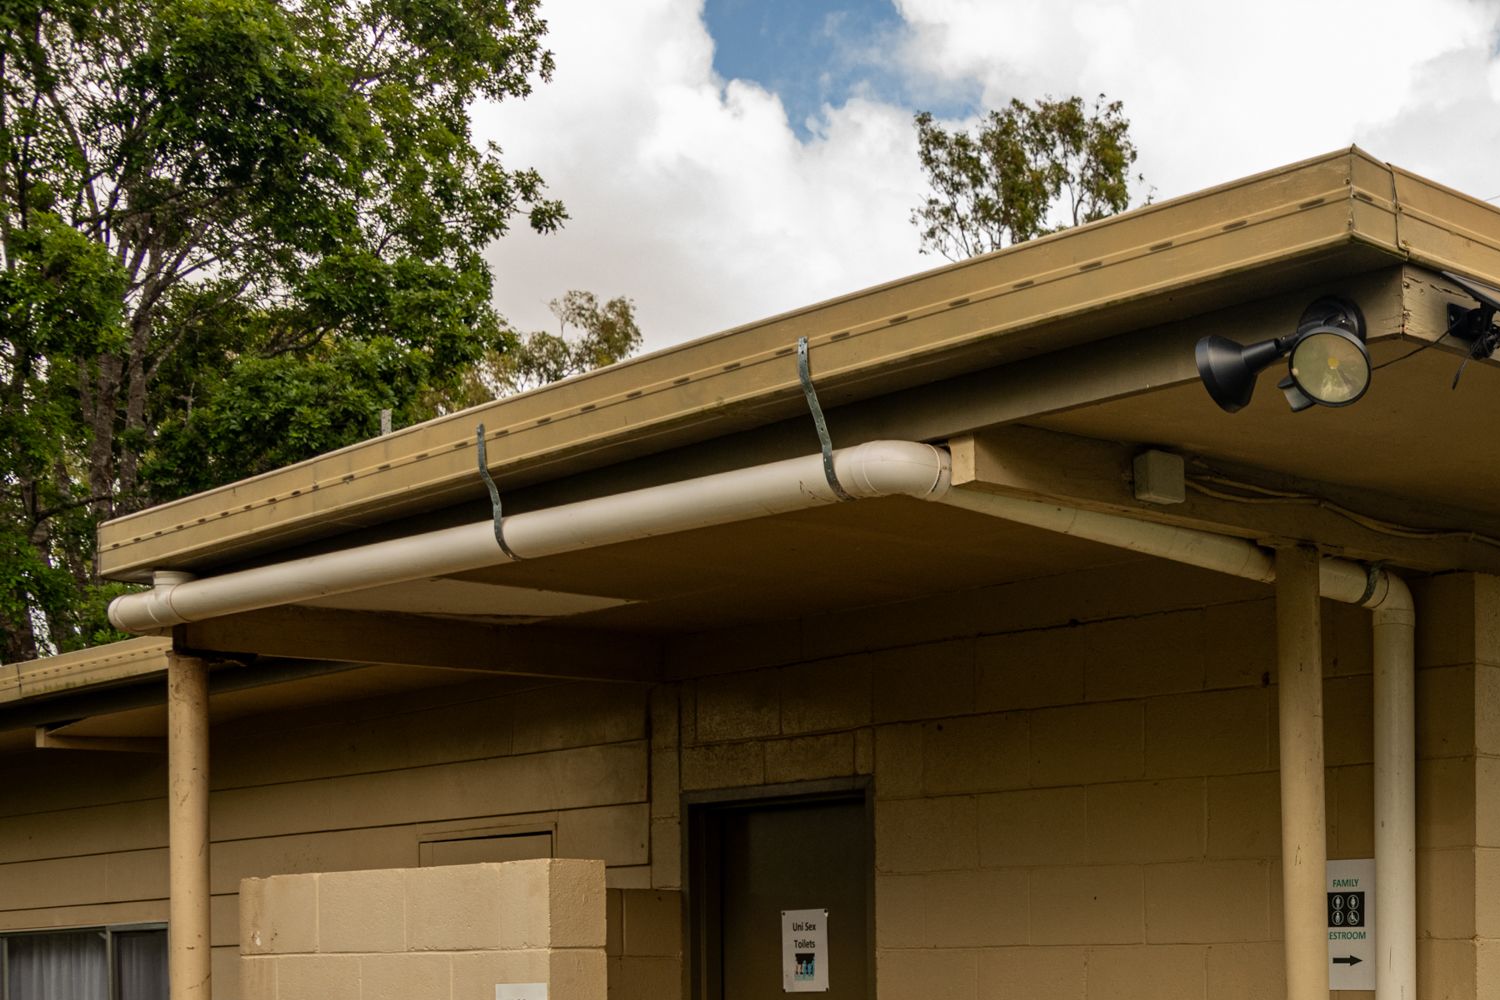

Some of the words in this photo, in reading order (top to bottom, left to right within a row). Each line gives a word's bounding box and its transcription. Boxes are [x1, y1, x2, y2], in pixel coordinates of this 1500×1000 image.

[1332, 878, 1359, 888] FAMILY
[792, 922, 804, 932] Uni
[804, 922, 816, 931] Sex
[1328, 931, 1366, 940] ESTROOM
[794, 940, 816, 949] Toilets
